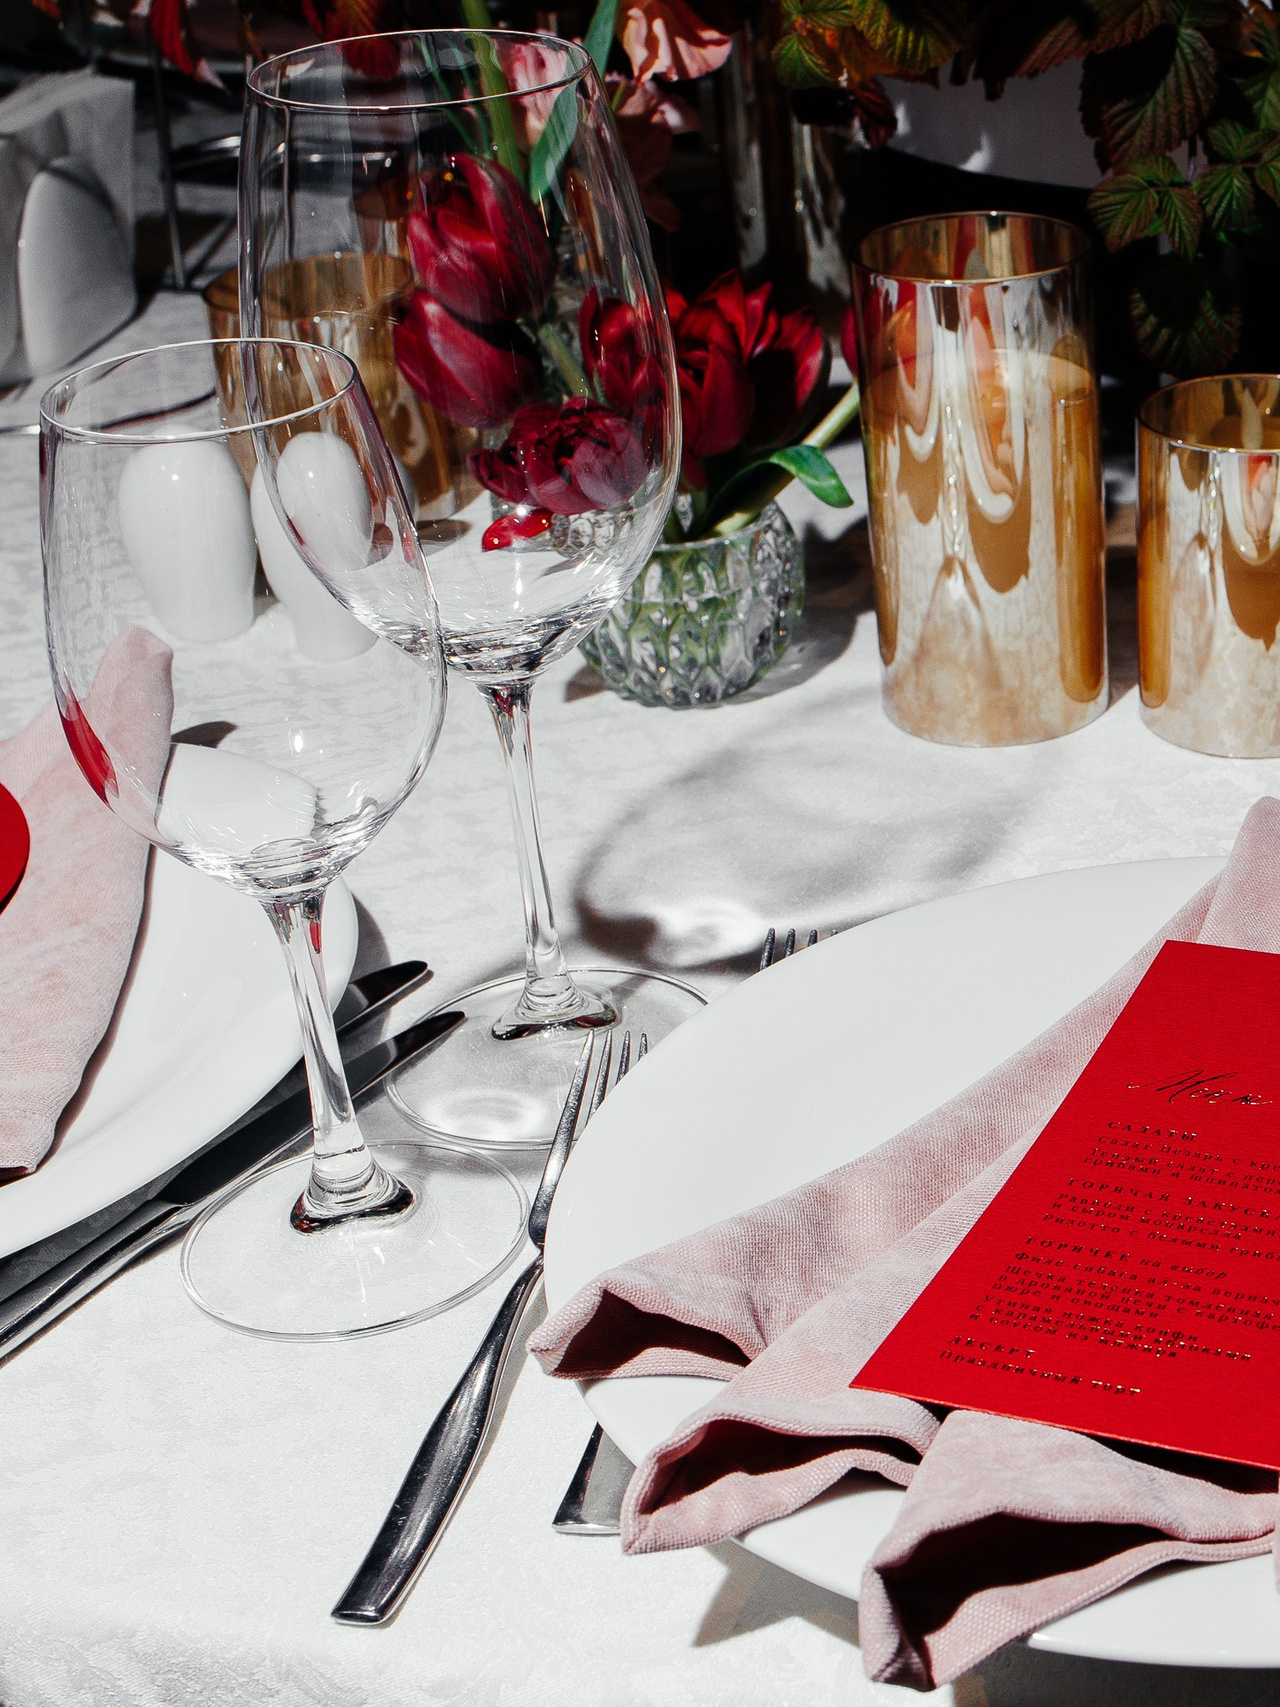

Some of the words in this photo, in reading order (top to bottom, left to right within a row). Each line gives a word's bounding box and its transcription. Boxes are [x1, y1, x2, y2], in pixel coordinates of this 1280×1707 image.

[1126, 1069, 1273, 1105] Меню
[1108, 1122, 1197, 1141] САЛАТЫ
[1098, 1136, 1152, 1150] Салат
[1160, 1144, 1223, 1162] Цезарь
[1084, 1158, 1161, 1175] грибами
[1169, 1171, 1182, 1179] и
[1167, 1161, 1219, 1175] салат
[1068, 1178, 1171, 1202] ГОРЯЧАЯ
[1051, 1201, 1063, 1210] и
[1071, 1205, 1130, 1220] сыром
[1143, 1208, 1153, 1216] с
[1128, 1229, 1139, 1237] с
[1147, 1231, 1220, 1251] белыми
[1015, 1252, 1064, 1267] Филе
[1073, 1264, 1138, 1281] сибаса
[1026, 1237, 1130, 1261] ГОРЯЧЕЕ
[1139, 1259, 1161, 1268] на
[1170, 1265, 1227, 1280] выбор
[992, 1283, 1041, 1296] пюре
[1049, 1293, 1062, 1302] и
[1071, 1298, 1159, 1318] овощами
[997, 1274, 1009, 1282] в
[1016, 1279, 1111, 1300] дровяной
[1120, 1297, 1167, 1310] печи
[1175, 1306, 1186, 1314] с
[968, 1312, 981, 1321] и
[989, 1317, 1057, 1335] соусом
[1065, 1332, 1089, 1341] из
[983, 1295, 1053, 1314] Утиная
[1062, 1312, 1124, 1328] ножка
[1134, 1325, 1198, 1342] конфи
[974, 1304, 986, 1312] с
[992, 1309, 1145, 1341] карамельными
[1153, 1337, 1251, 1361] яблоками
[949, 1336, 1035, 1358] ДЕСЕРТ
[940, 1351, 1082, 1385] Праздничный
[1091, 1380, 1141, 1396] торт
